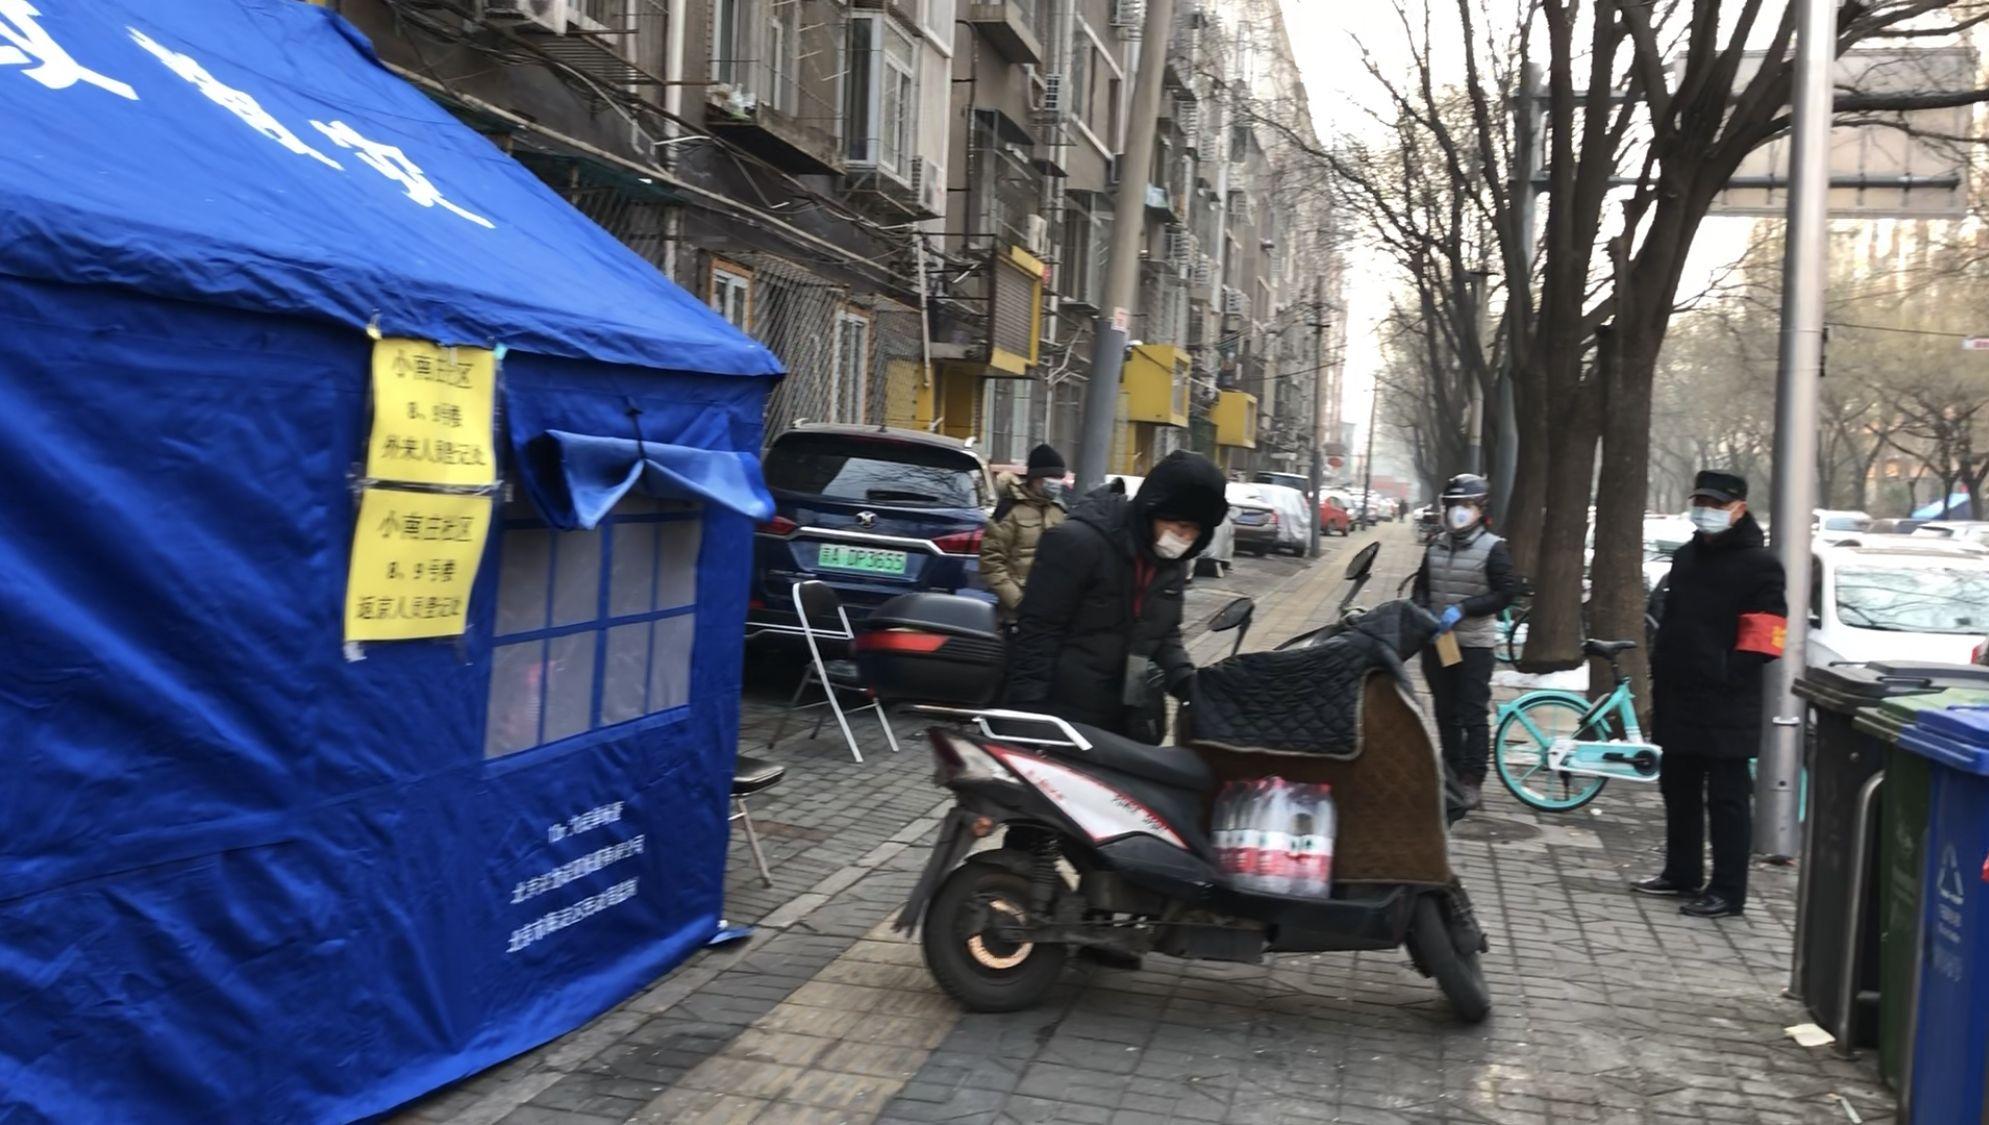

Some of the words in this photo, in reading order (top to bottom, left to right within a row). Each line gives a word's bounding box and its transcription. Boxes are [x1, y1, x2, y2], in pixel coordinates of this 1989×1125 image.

[377, 509, 475, 543] 小南庄社区
[354, 595, 464, 620] 返京人员登记处
